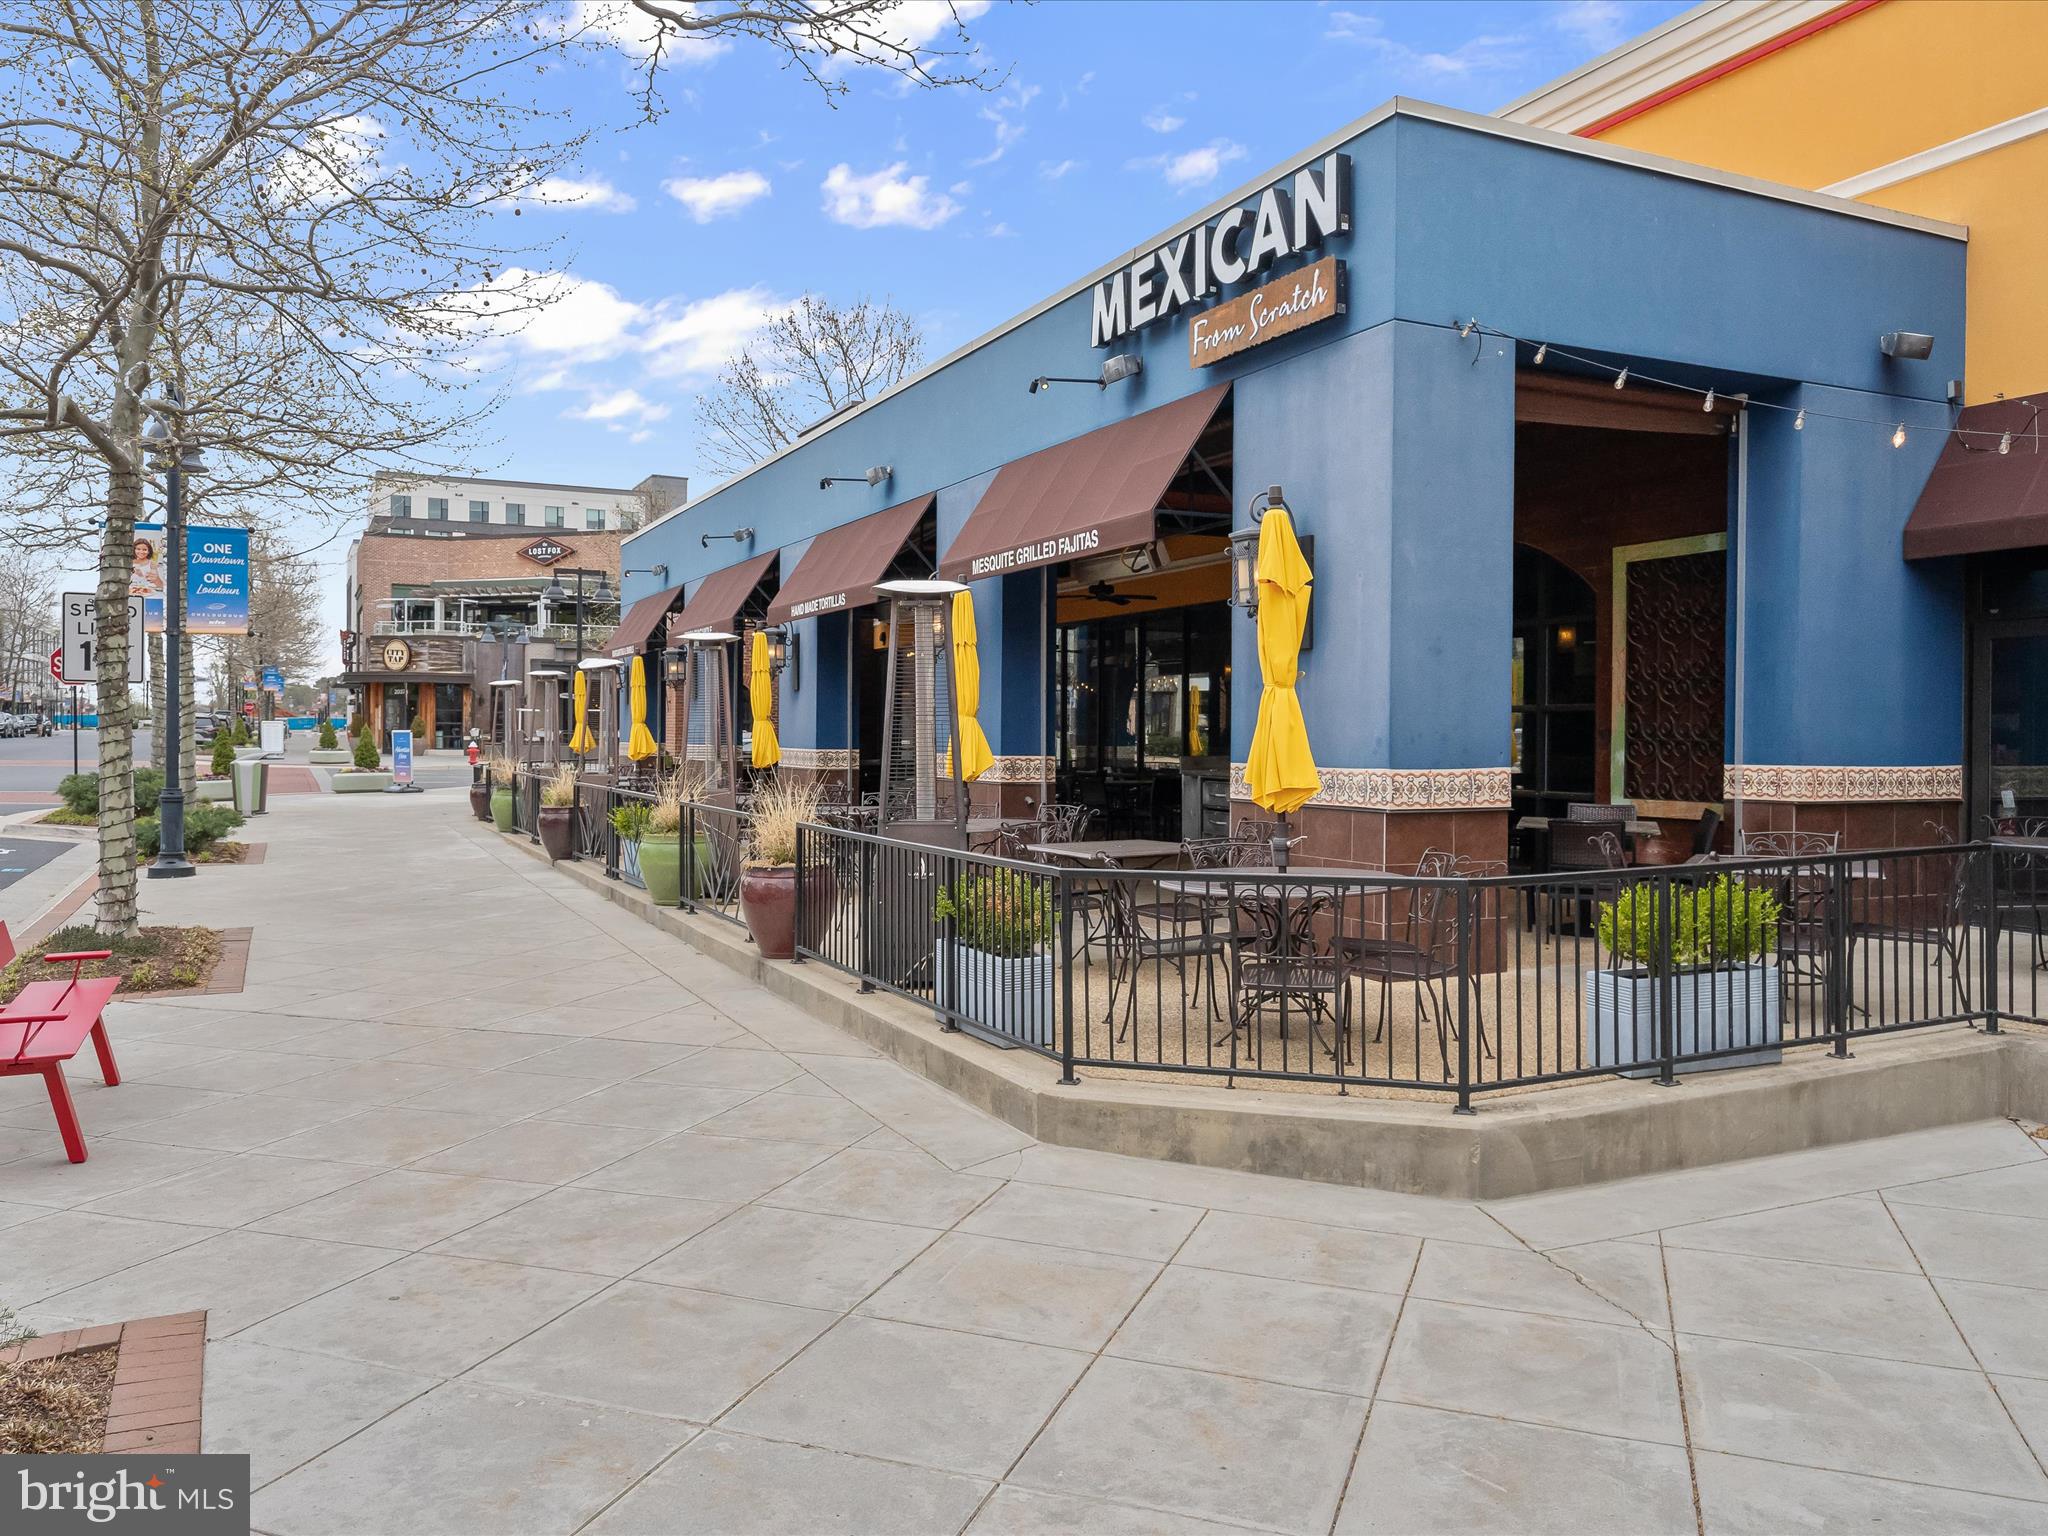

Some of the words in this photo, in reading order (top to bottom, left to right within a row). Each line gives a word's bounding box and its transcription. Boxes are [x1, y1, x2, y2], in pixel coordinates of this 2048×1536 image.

[1091, 152, 1342, 348] MEXICAN
[1193, 318, 1246, 356] From
[1249, 267, 1329, 341] Scratch
[203, 543, 232, 554] ONE
[528, 547, 547, 555] LOST
[547, 546, 561, 554] FOX
[972, 551, 1015, 575] MESQUITE
[1016, 541, 1057, 565] GRILLED
[1058, 529, 1099, 555] FAJITAS
[191, 552, 245, 566] Downtown
[203, 573, 232, 584] ONE
[196, 584, 240, 595] Loudoun
[804, 599, 819, 614] MADE
[818, 592, 846, 610] TORTILLAS
[70, 603, 137, 618] SPD
[388, 655, 403, 663] TAP
